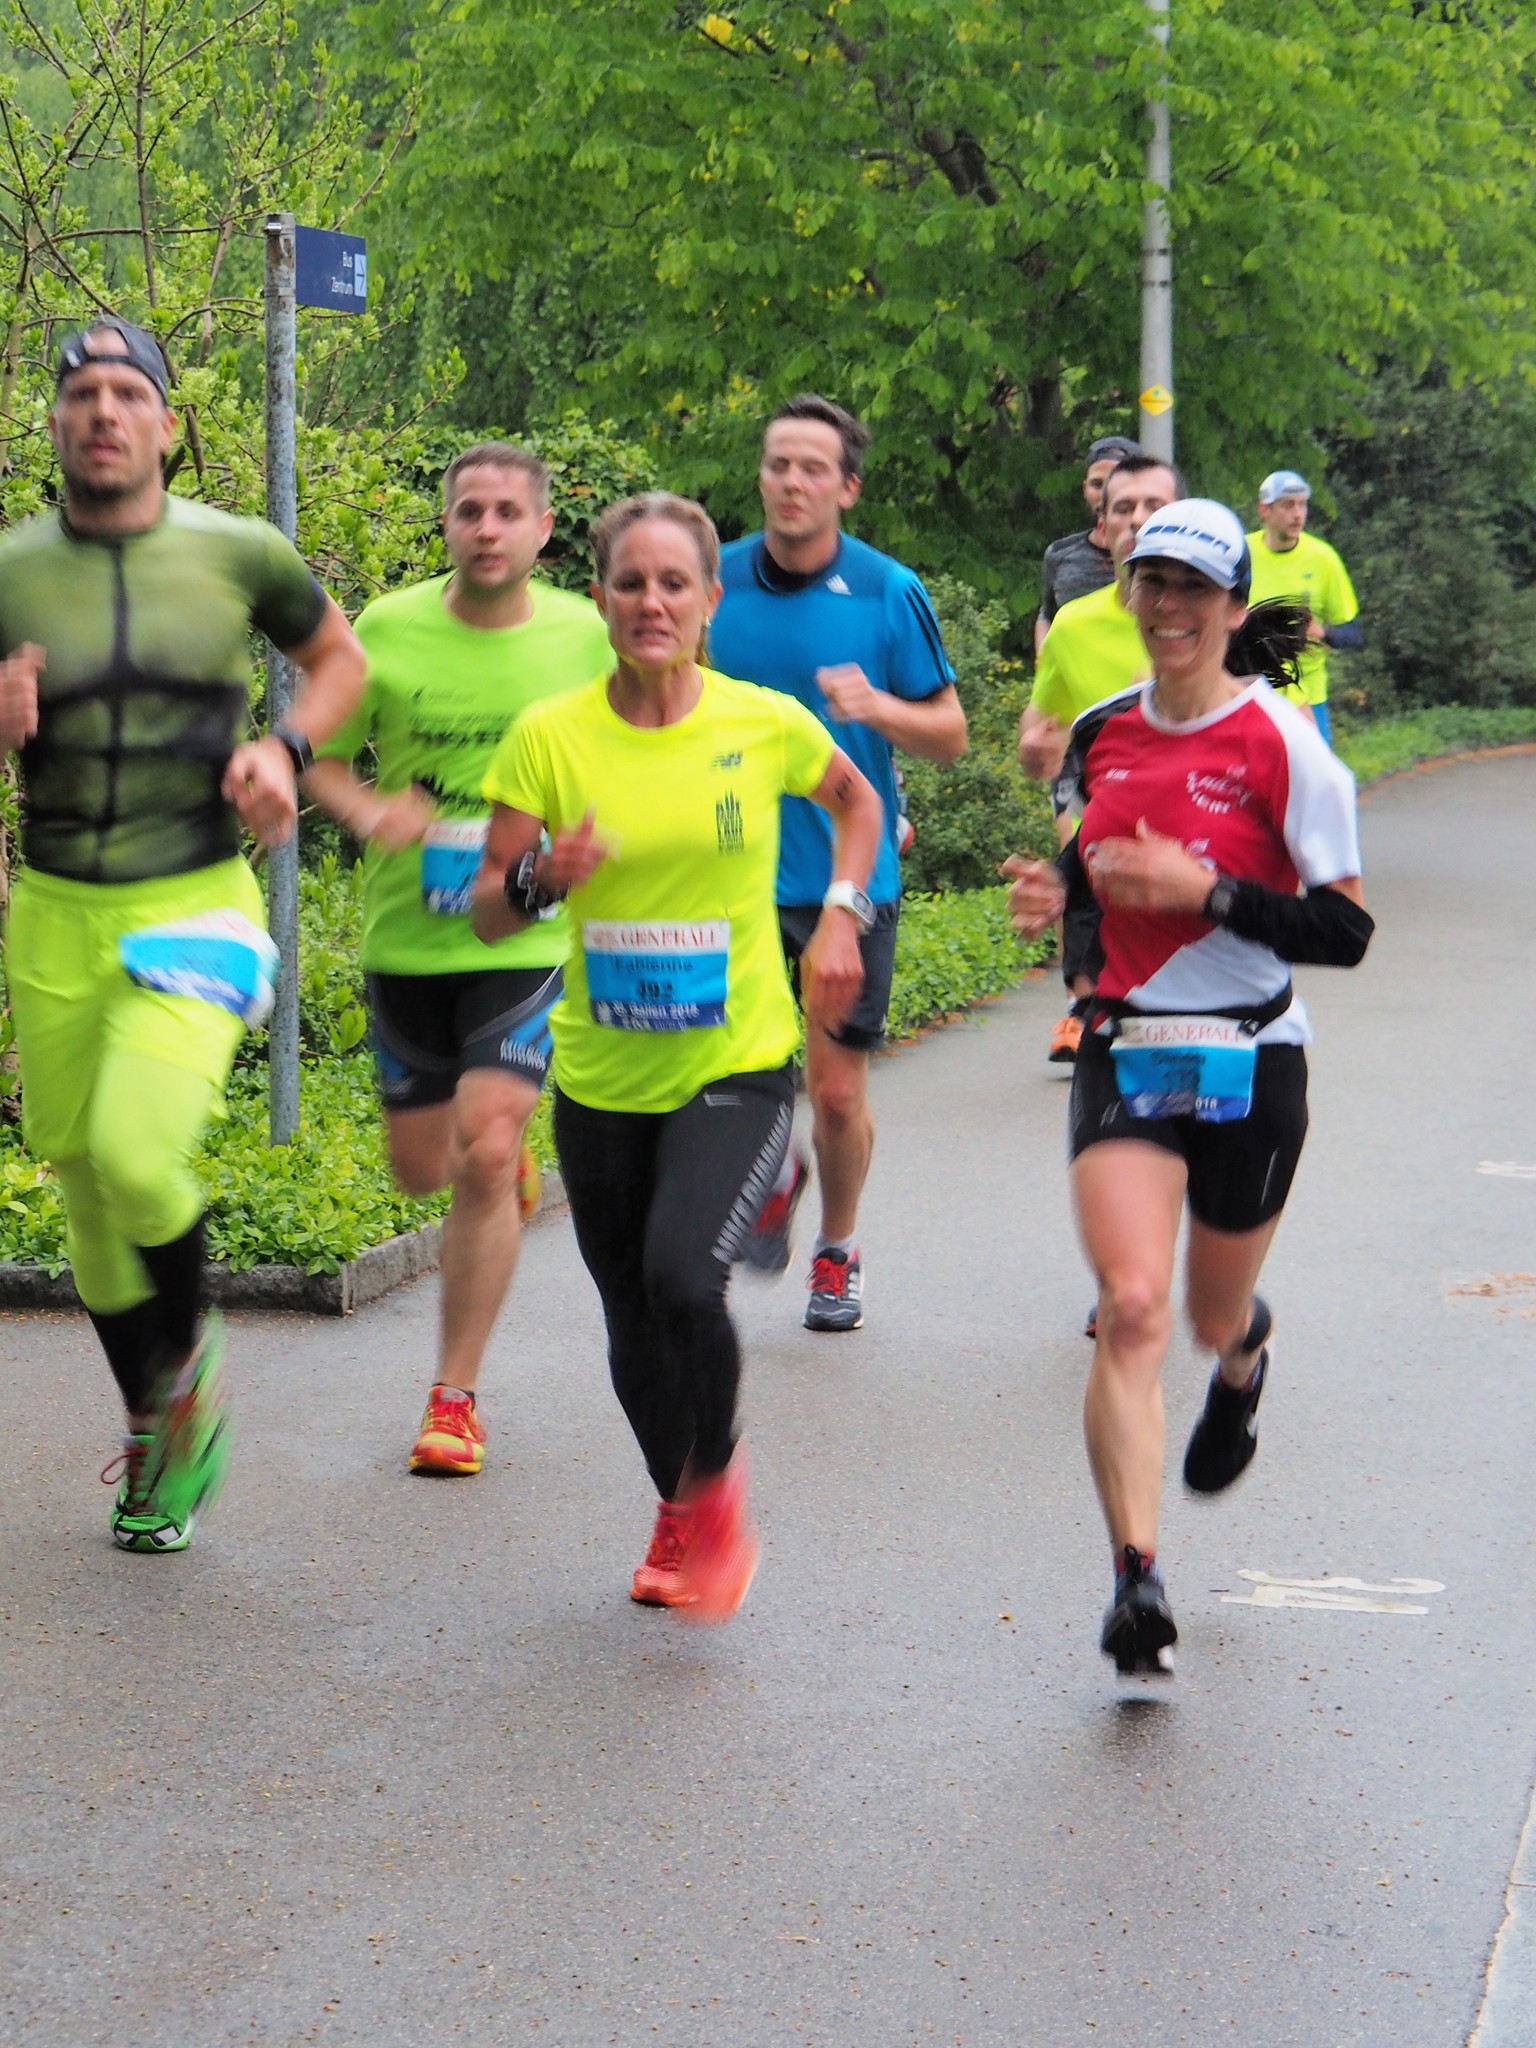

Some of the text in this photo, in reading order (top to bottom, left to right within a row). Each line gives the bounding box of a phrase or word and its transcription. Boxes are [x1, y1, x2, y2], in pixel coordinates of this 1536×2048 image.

[330, 276, 353, 295] Zentrum
[620, 928, 716, 947] GENERALI
[1145, 1022, 1241, 1043] GENERALI
